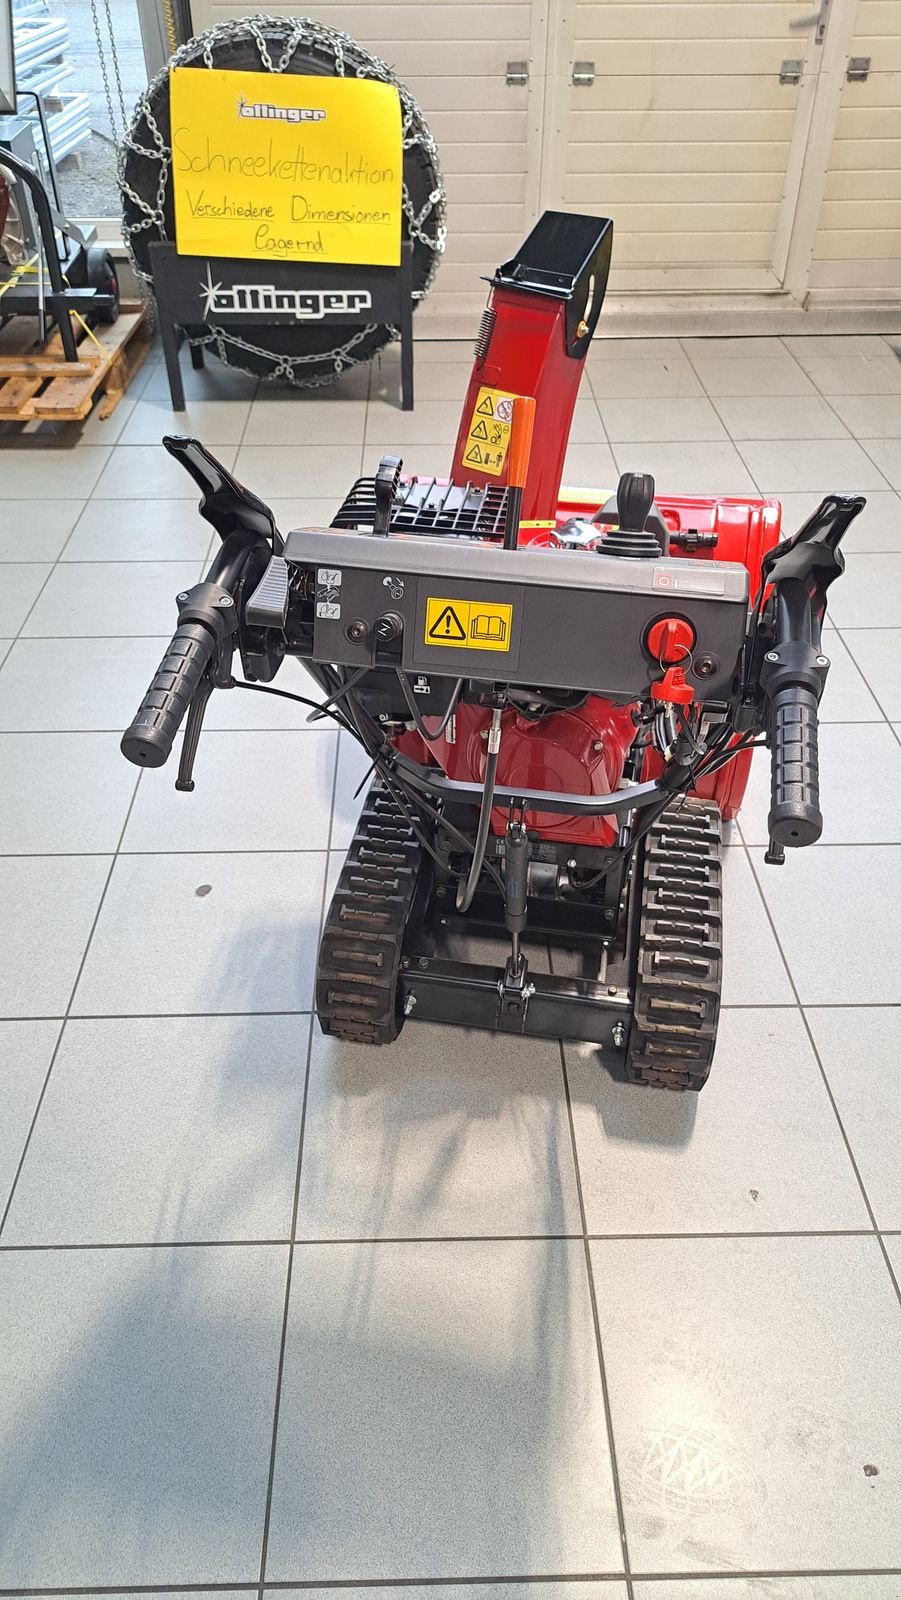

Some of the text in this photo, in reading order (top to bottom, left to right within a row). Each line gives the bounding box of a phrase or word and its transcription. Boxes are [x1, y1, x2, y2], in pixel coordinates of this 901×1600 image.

[174, 127, 394, 185] Schneekettenaktion
[186, 189, 391, 222] Verschiedene Dimensionen
